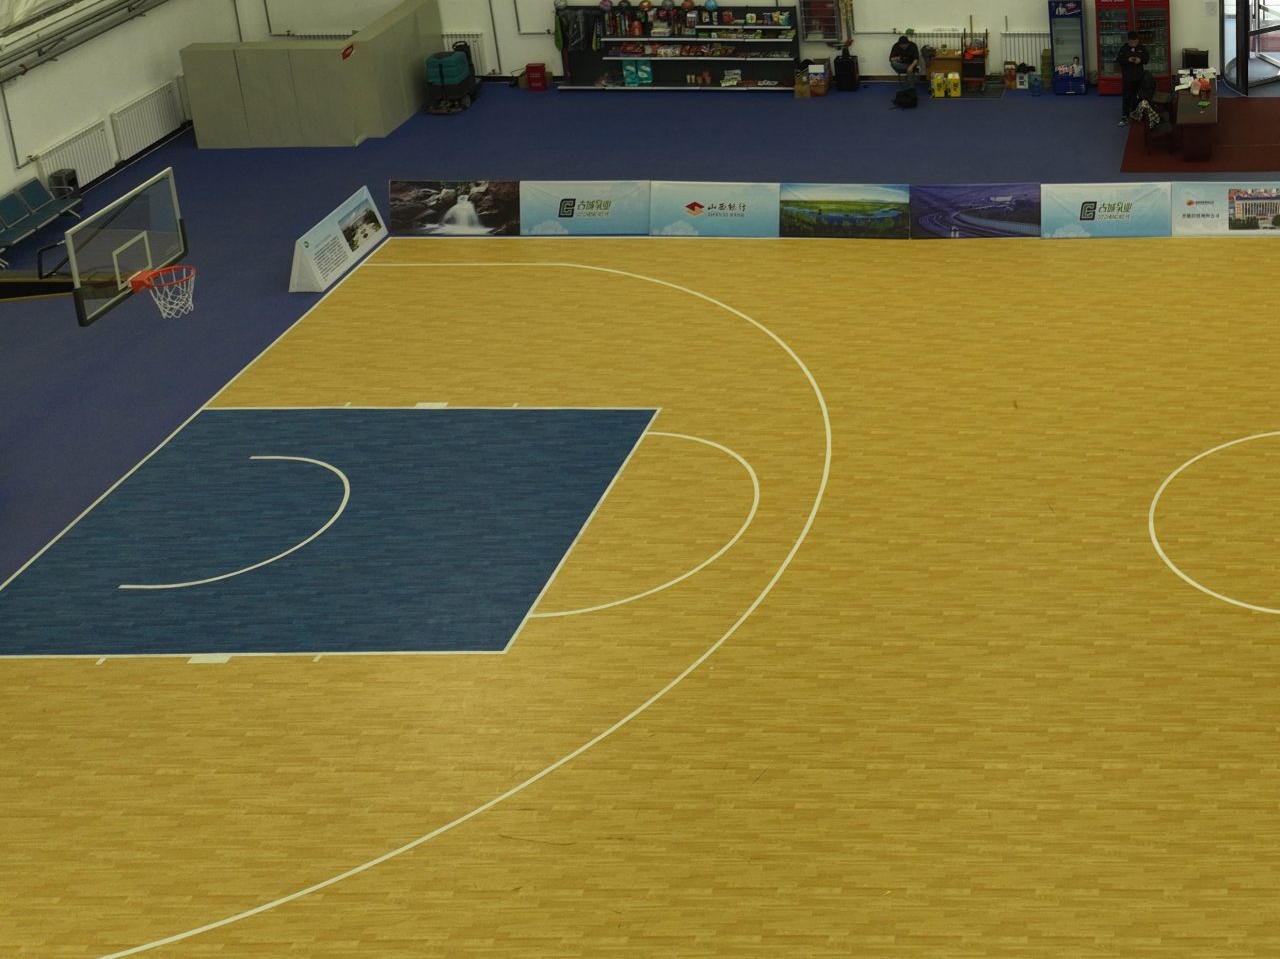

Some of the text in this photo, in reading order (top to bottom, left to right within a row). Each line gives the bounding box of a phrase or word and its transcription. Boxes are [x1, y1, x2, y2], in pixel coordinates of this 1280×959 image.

[577, 199, 611, 210] 古城乳业
[707, 202, 746, 212] 山西银行
[1098, 201, 1132, 212] 古城乳业
